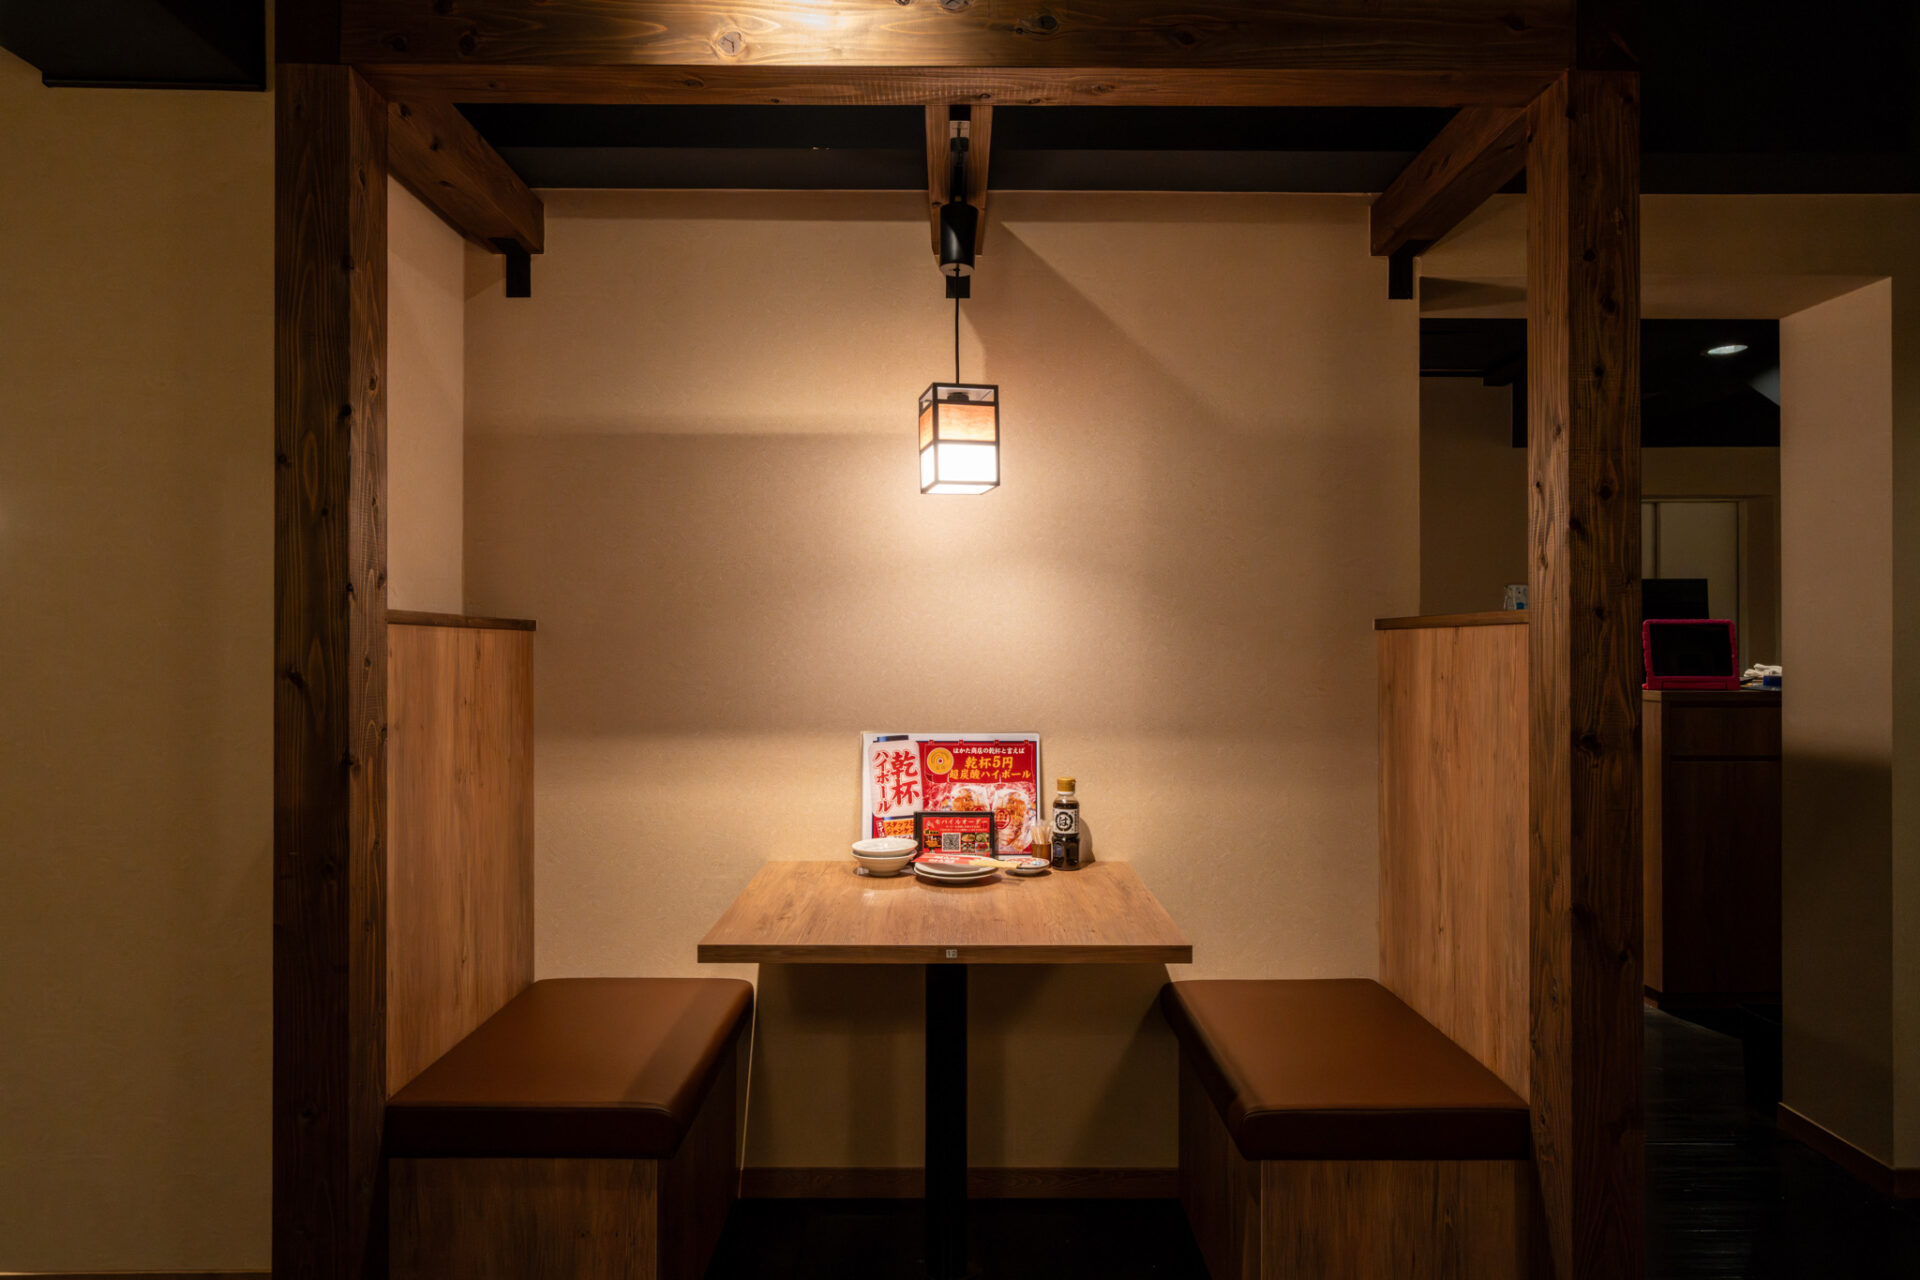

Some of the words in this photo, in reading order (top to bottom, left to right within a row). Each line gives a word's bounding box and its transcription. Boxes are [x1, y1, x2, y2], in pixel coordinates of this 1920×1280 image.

[875, 751, 891, 812] ハイボール
[891, 751, 920, 805] 乾杯
[965, 755, 1014, 769] 乾杯5円
